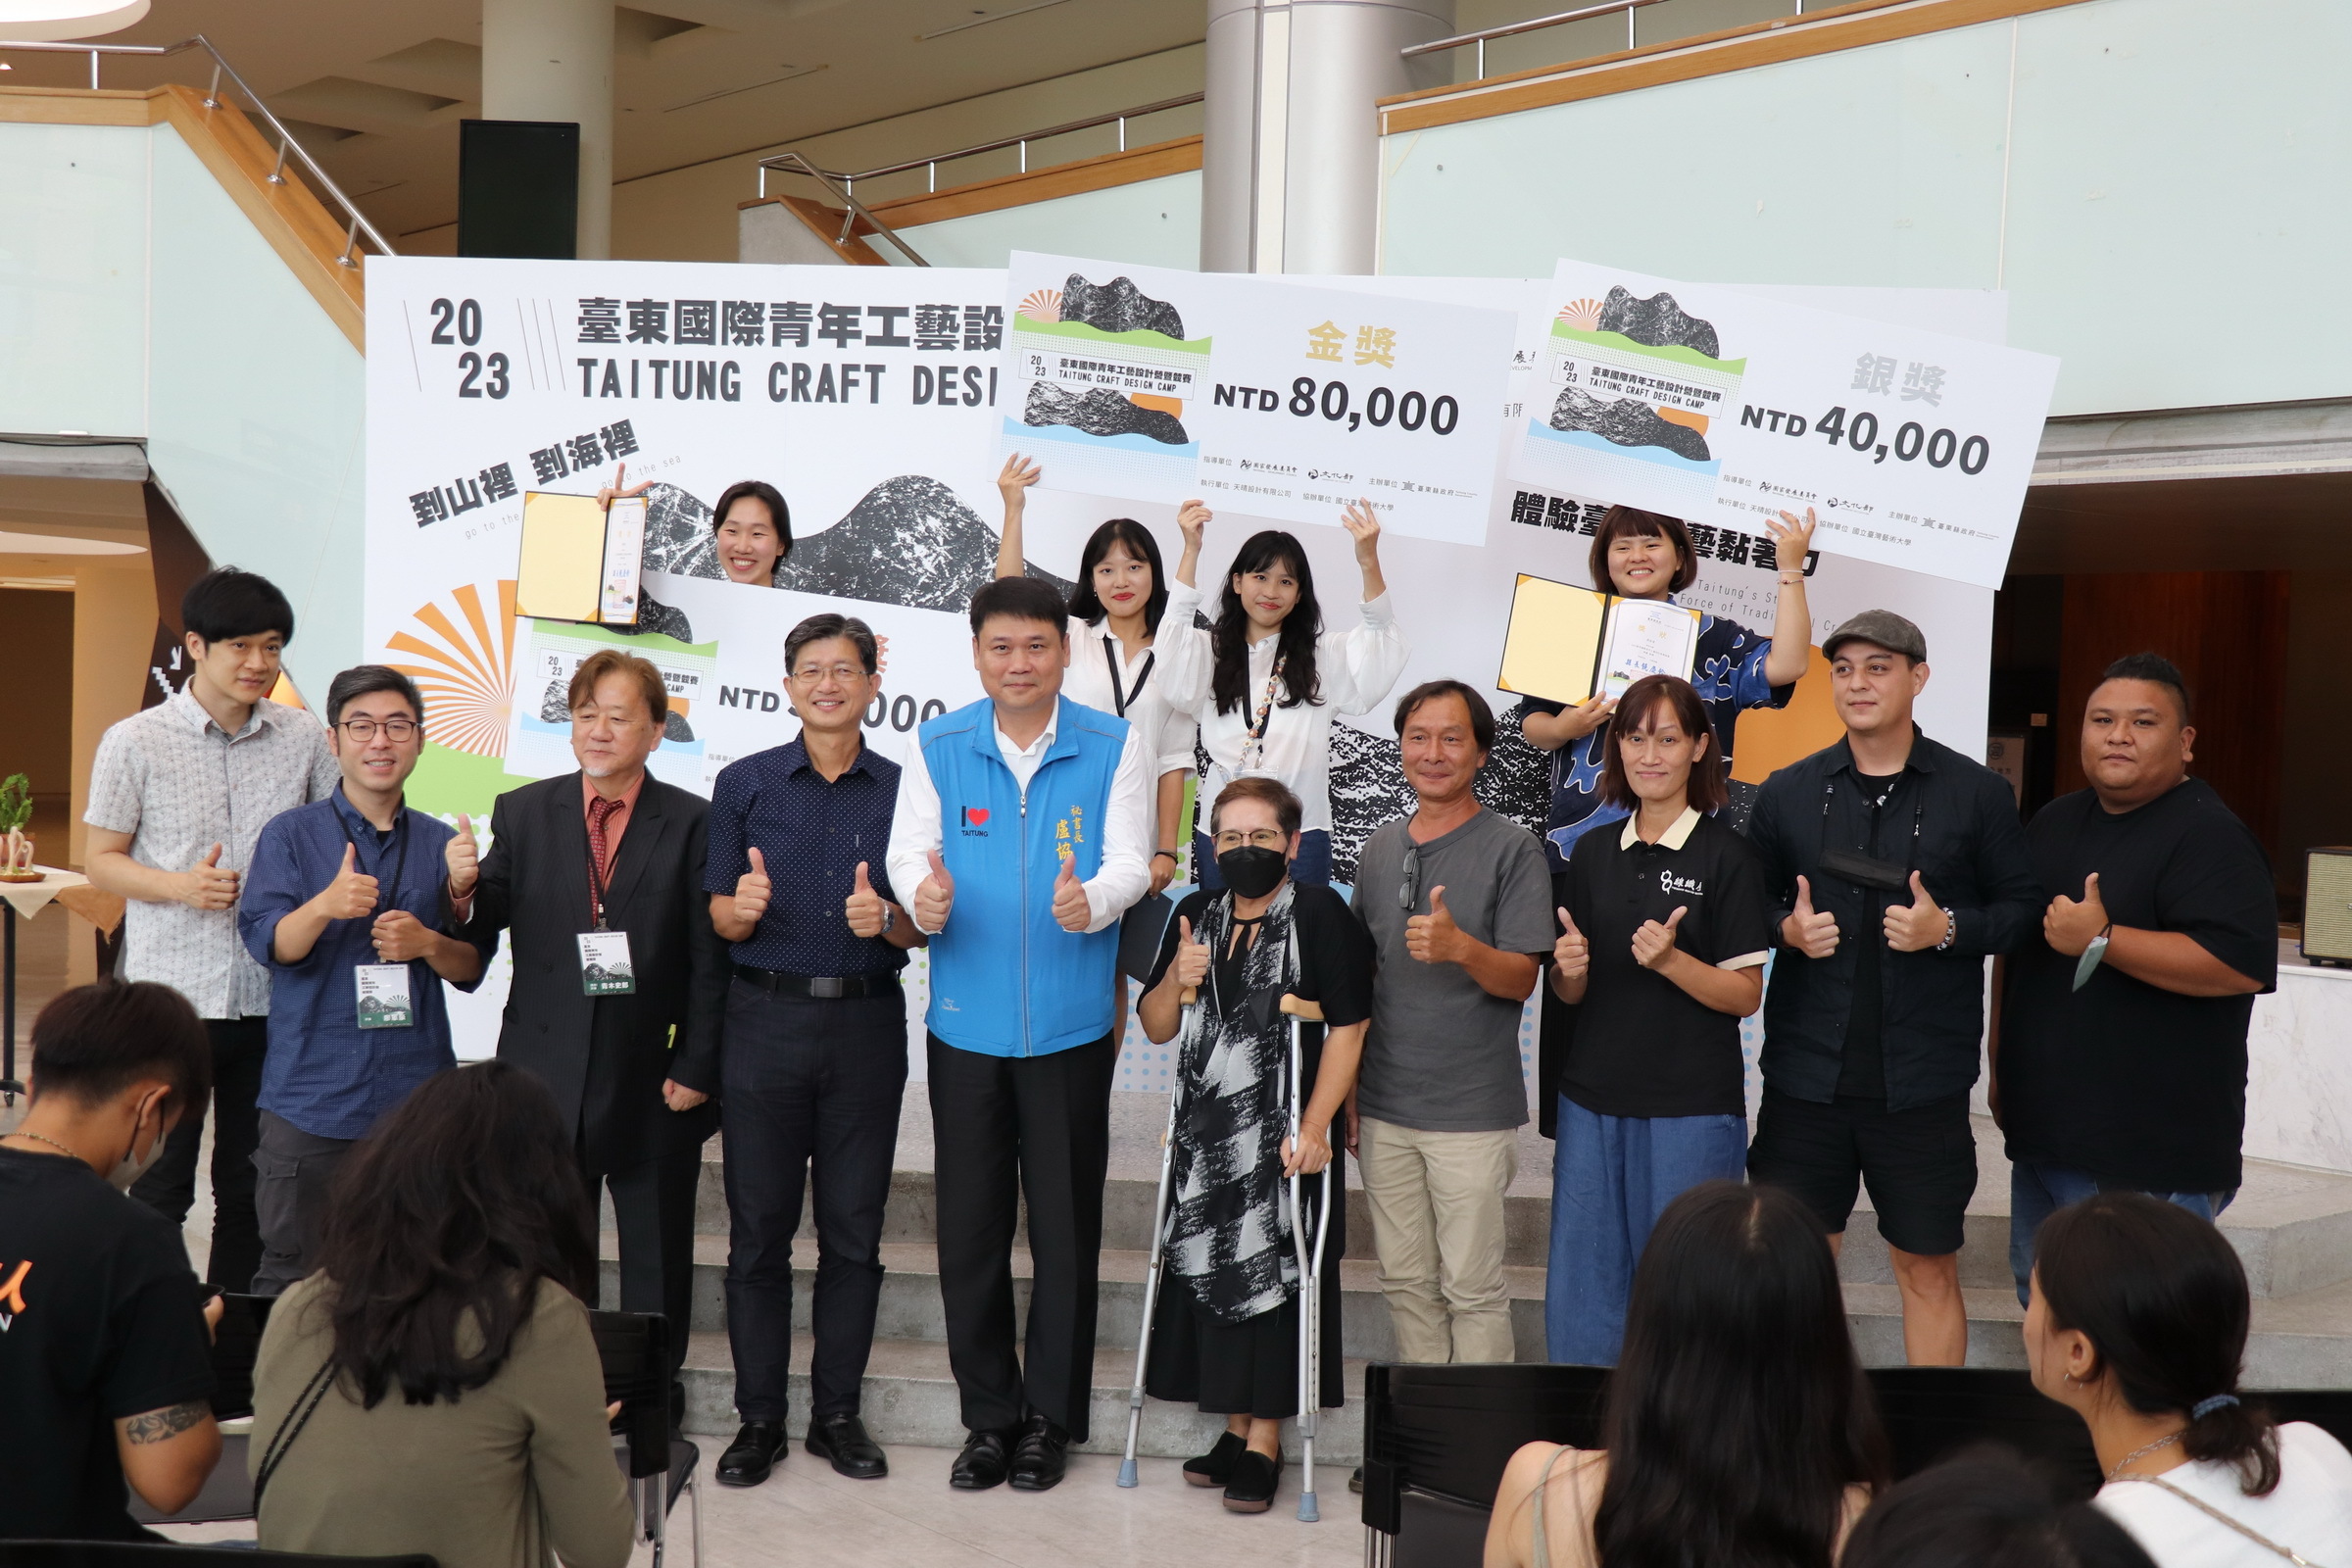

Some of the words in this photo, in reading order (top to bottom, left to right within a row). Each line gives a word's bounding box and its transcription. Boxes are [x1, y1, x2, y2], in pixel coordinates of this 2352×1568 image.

[430, 297, 483, 347] 20
[577, 297, 1004, 352] 臺東國際青年工藝設
[1031, 355, 1043, 366] 20
[1305, 319, 1397, 369] 金獎
[458, 351, 511, 400] 23
[1035, 367, 1047, 377] 23
[1058, 369, 1092, 382] TAITUNG
[1097, 374, 1120, 386] CRAFT
[1124, 378, 1153, 390] DESIGN
[1157, 382, 1177, 393] CAMP
[1059, 358, 1193, 384] 臺東國際青年工藝設計營暨競賽
[1563, 361, 1575, 371] 20
[1566, 371, 1578, 383] 23
[1850, 351, 1947, 409] 銀獎
[577, 358, 741, 403] TAITUNG
[768, 362, 887, 405] CRAFT
[912, 365, 999, 408] DESI
[1590, 377, 1622, 393] TAITUNG
[1626, 386, 1650, 399] CRAFT
[1652, 392, 1682, 406] DESIGN
[1686, 398, 1705, 410] CAMP
[1591, 366, 1722, 403] 臺東國際青年工藝設計營暨競賽
[1213, 383, 1280, 413] NTD
[1289, 376, 1459, 436] 80,000
[1740, 404, 1807, 438] NTD
[1815, 405, 1990, 476] 40,000
[409, 461, 519, 529] 到山裡
[528, 417, 640, 486] 到海裡
[601, 478, 614, 490] go
[639, 463, 657, 478] the
[663, 455, 682, 467] sea
[466, 529, 477, 540] go
[484, 521, 496, 532] to
[502, 513, 520, 527] the
[1680, 593, 1713, 610] Force
[1721, 603, 1734, 612] of
[548, 656, 560, 665] 20
[552, 666, 563, 676] 23
[667, 683, 685, 694] CAMP
[718, 685, 780, 712] NTD
[1055, 818, 1074, 868] 盧協
